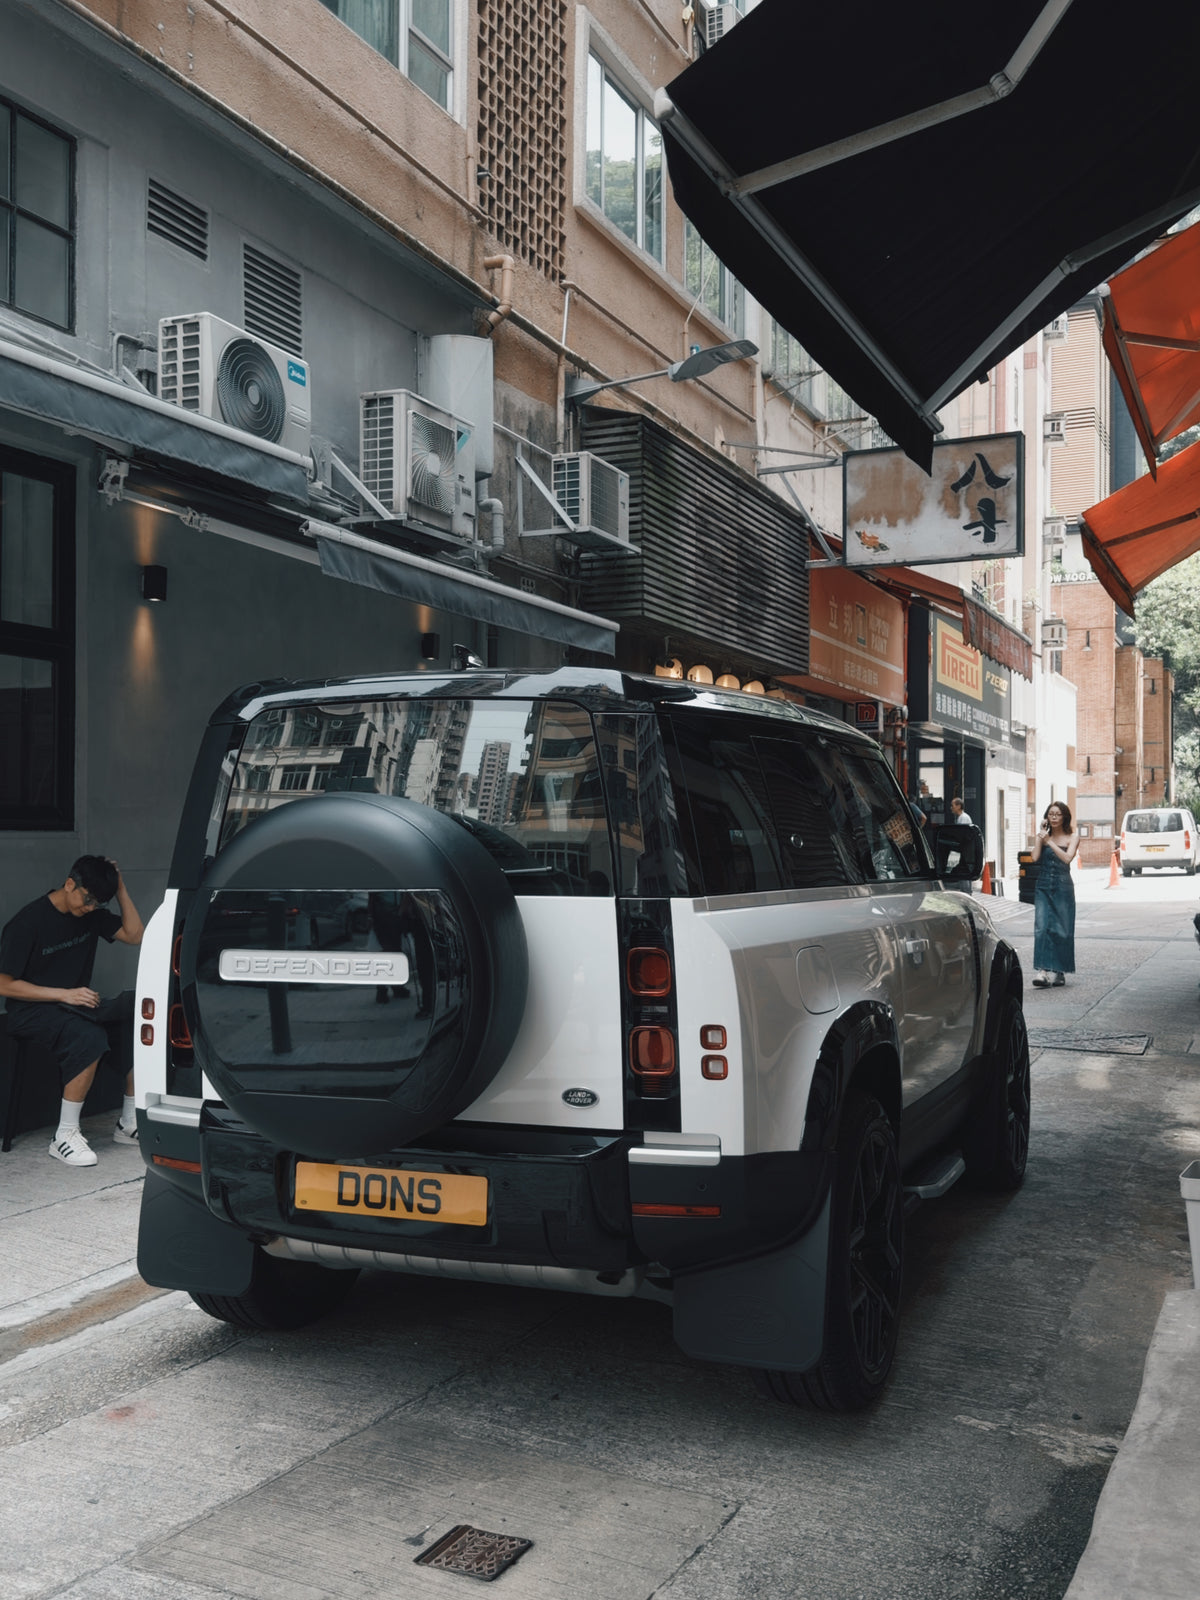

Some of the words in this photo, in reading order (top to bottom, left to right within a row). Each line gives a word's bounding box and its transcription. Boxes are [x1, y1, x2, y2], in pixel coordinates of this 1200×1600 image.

[941, 631, 979, 690] PIRELLI
[233, 956, 394, 976] DEFENDER
[337, 1171, 442, 1214] DONS
